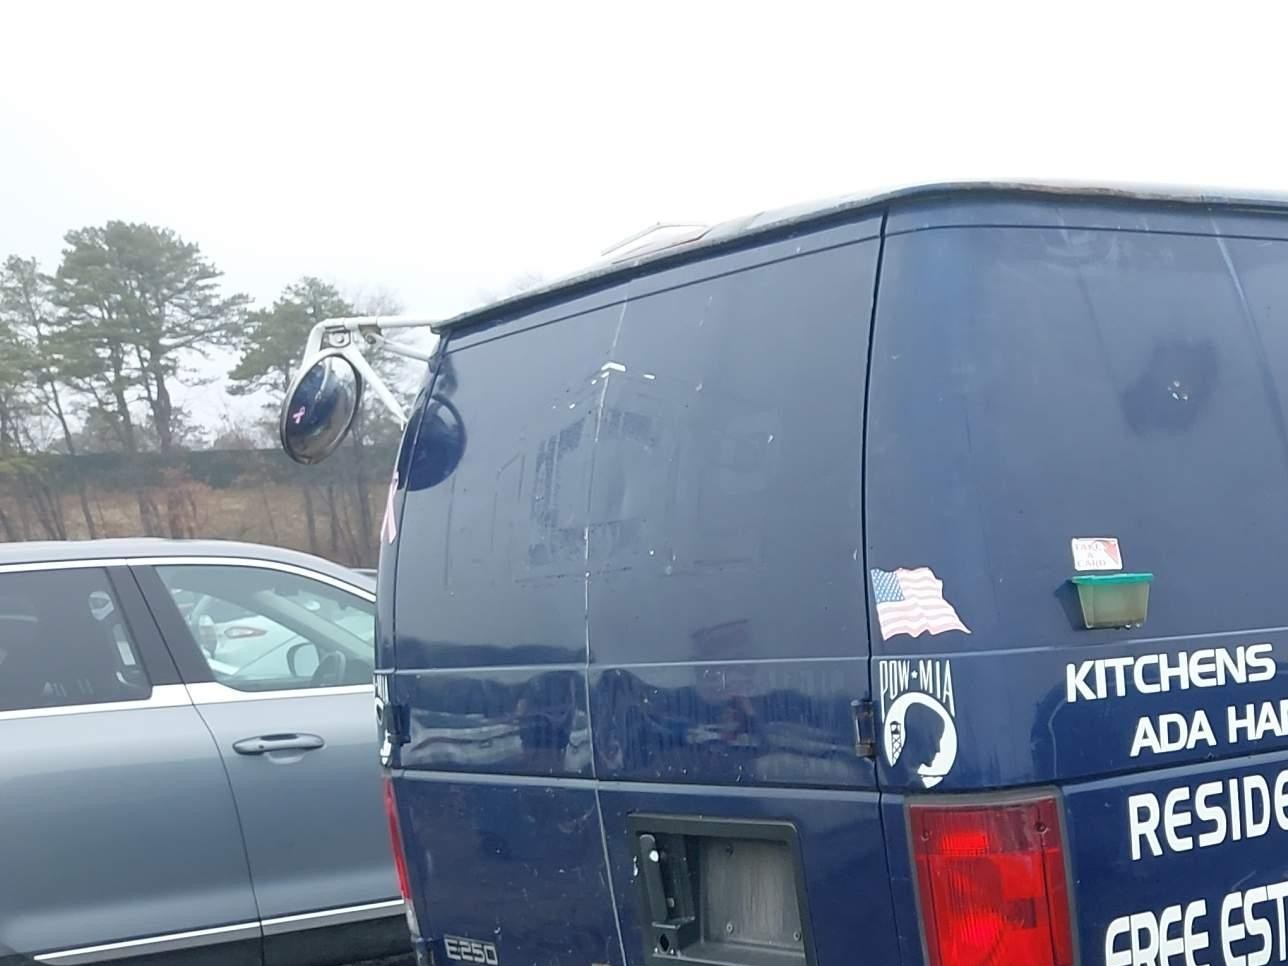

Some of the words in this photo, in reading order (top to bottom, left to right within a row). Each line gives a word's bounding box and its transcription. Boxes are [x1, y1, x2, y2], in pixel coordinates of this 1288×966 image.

[879, 660, 910, 724] POW
[918, 659, 956, 719] MIA
[1066, 643, 1276, 702] KITCHENS
[1130, 711, 1216, 757] ADA
[444, 938, 499, 966] E250
